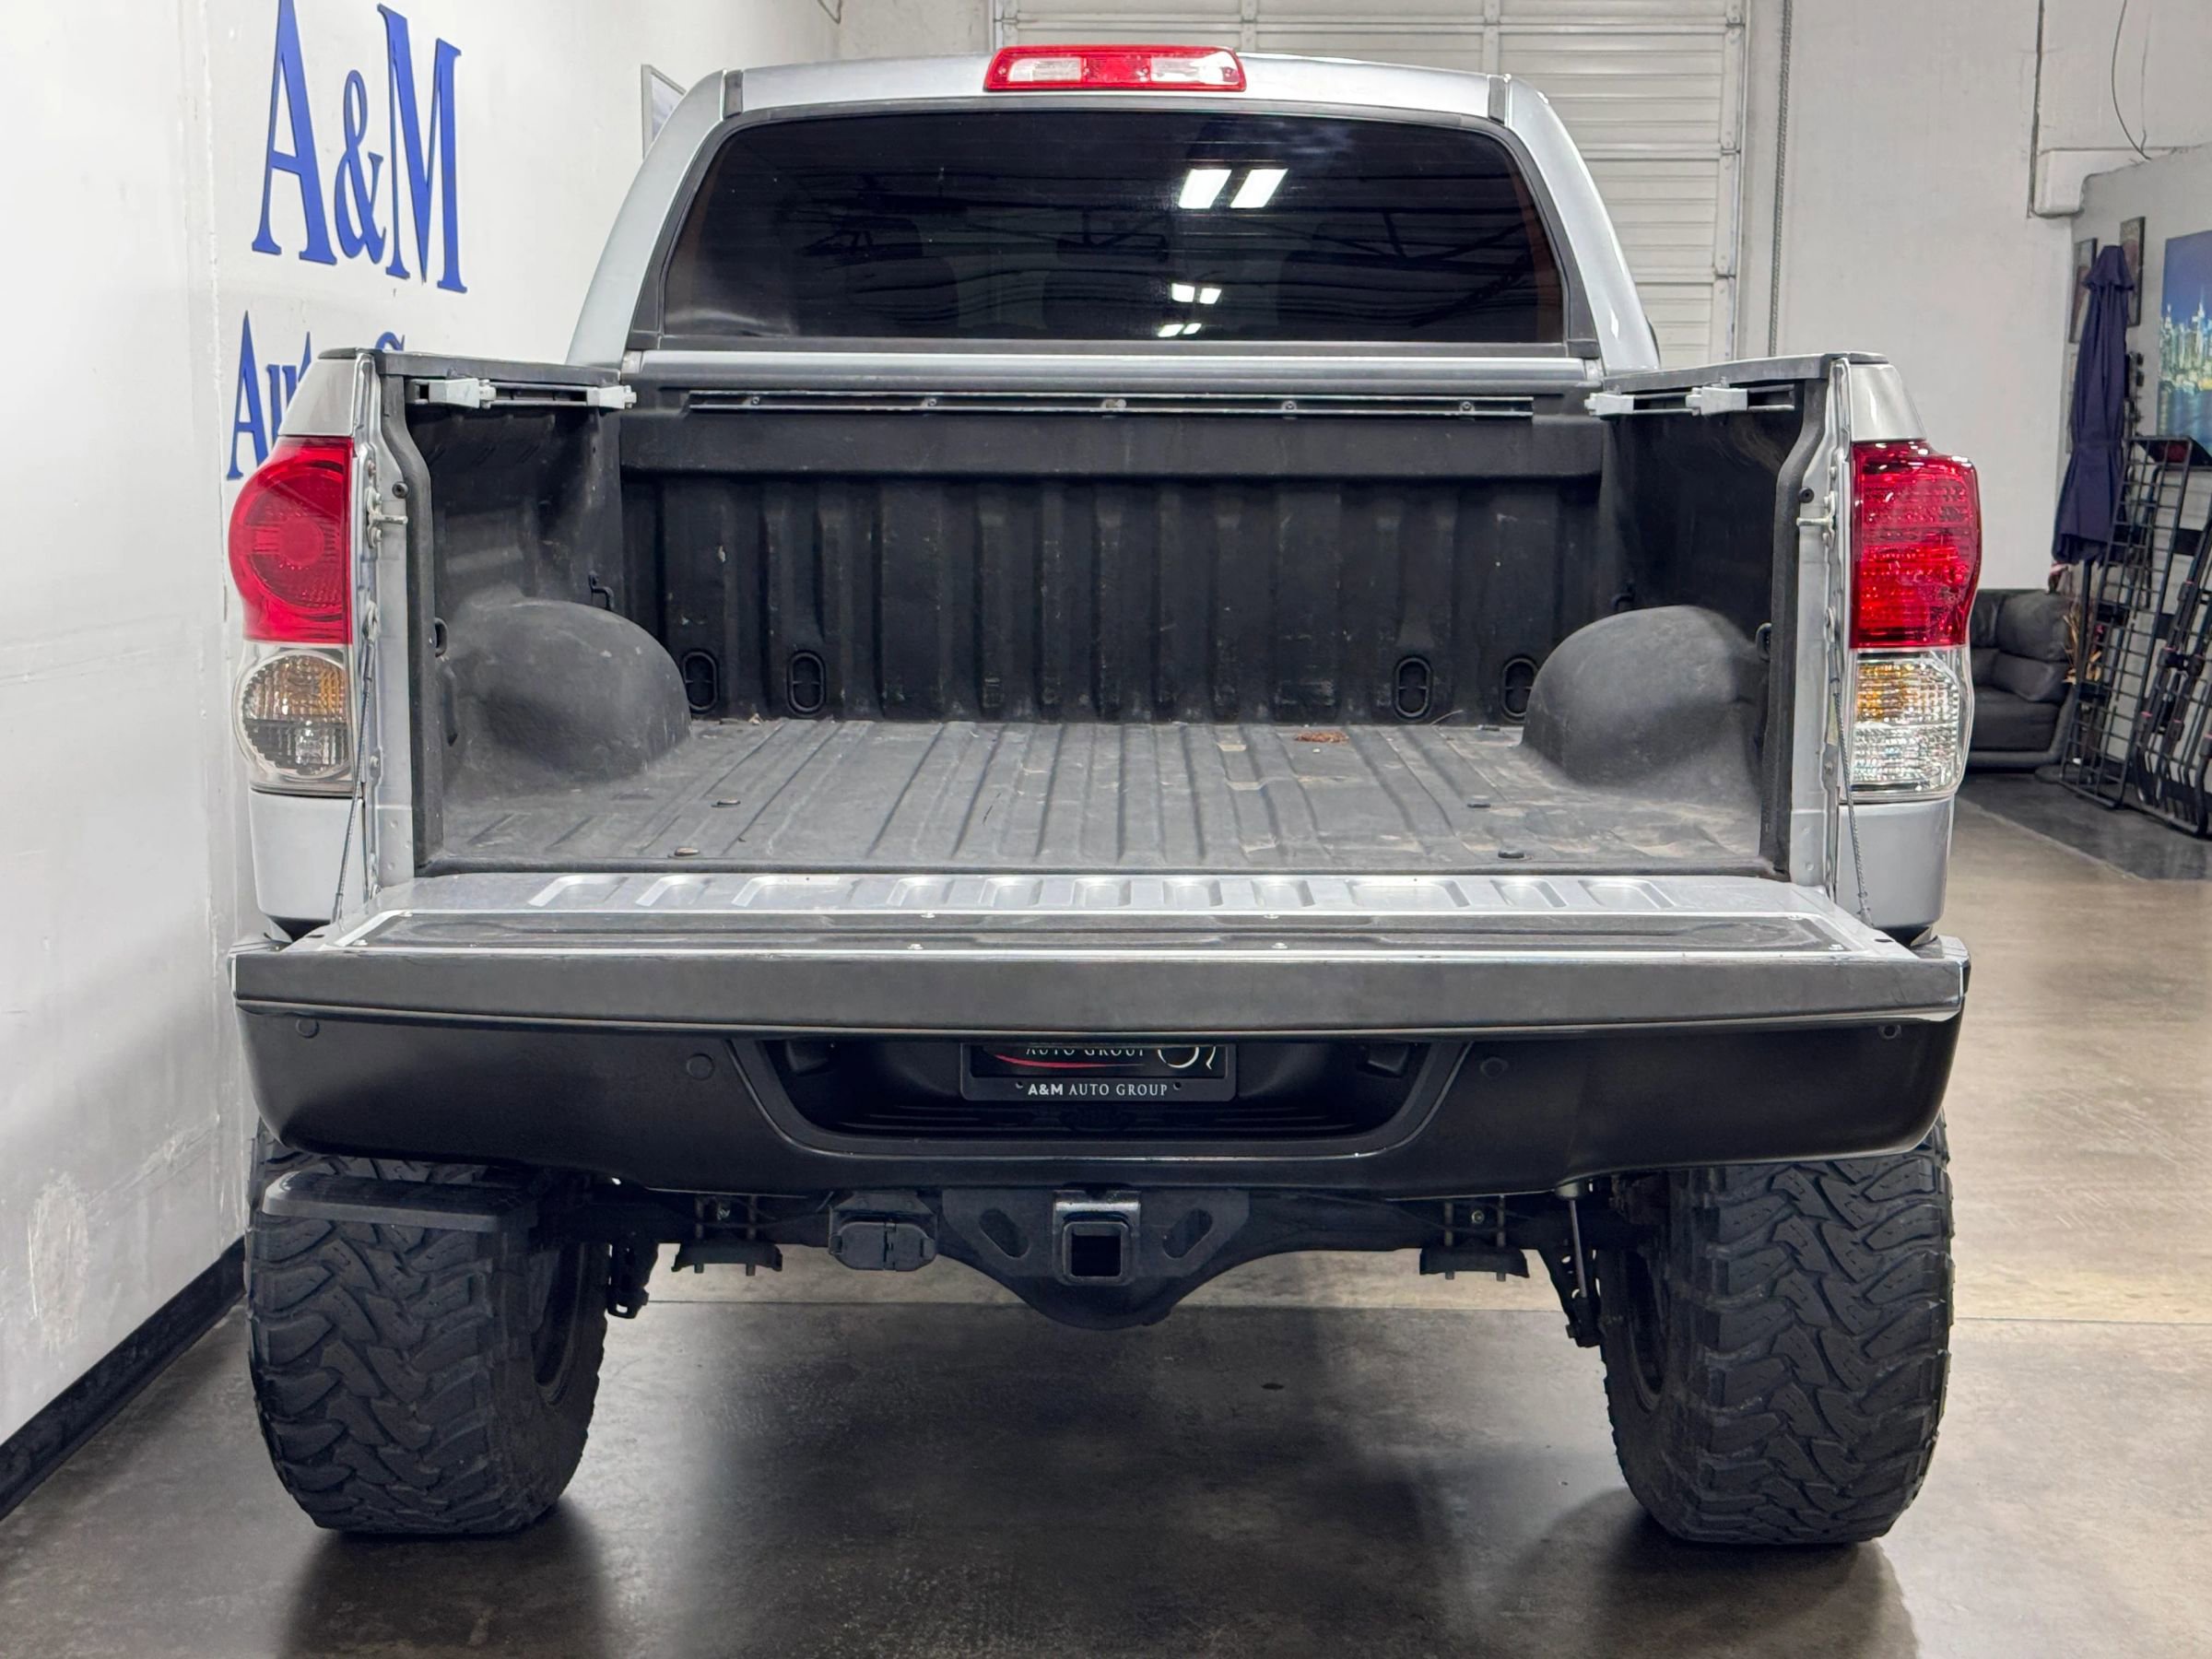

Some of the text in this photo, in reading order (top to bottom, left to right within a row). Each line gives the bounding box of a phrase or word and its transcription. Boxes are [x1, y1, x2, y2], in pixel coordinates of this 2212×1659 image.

[252, 0, 467, 294] A&M
[1028, 1084, 1168, 1097] A&M AUTO GROUP
